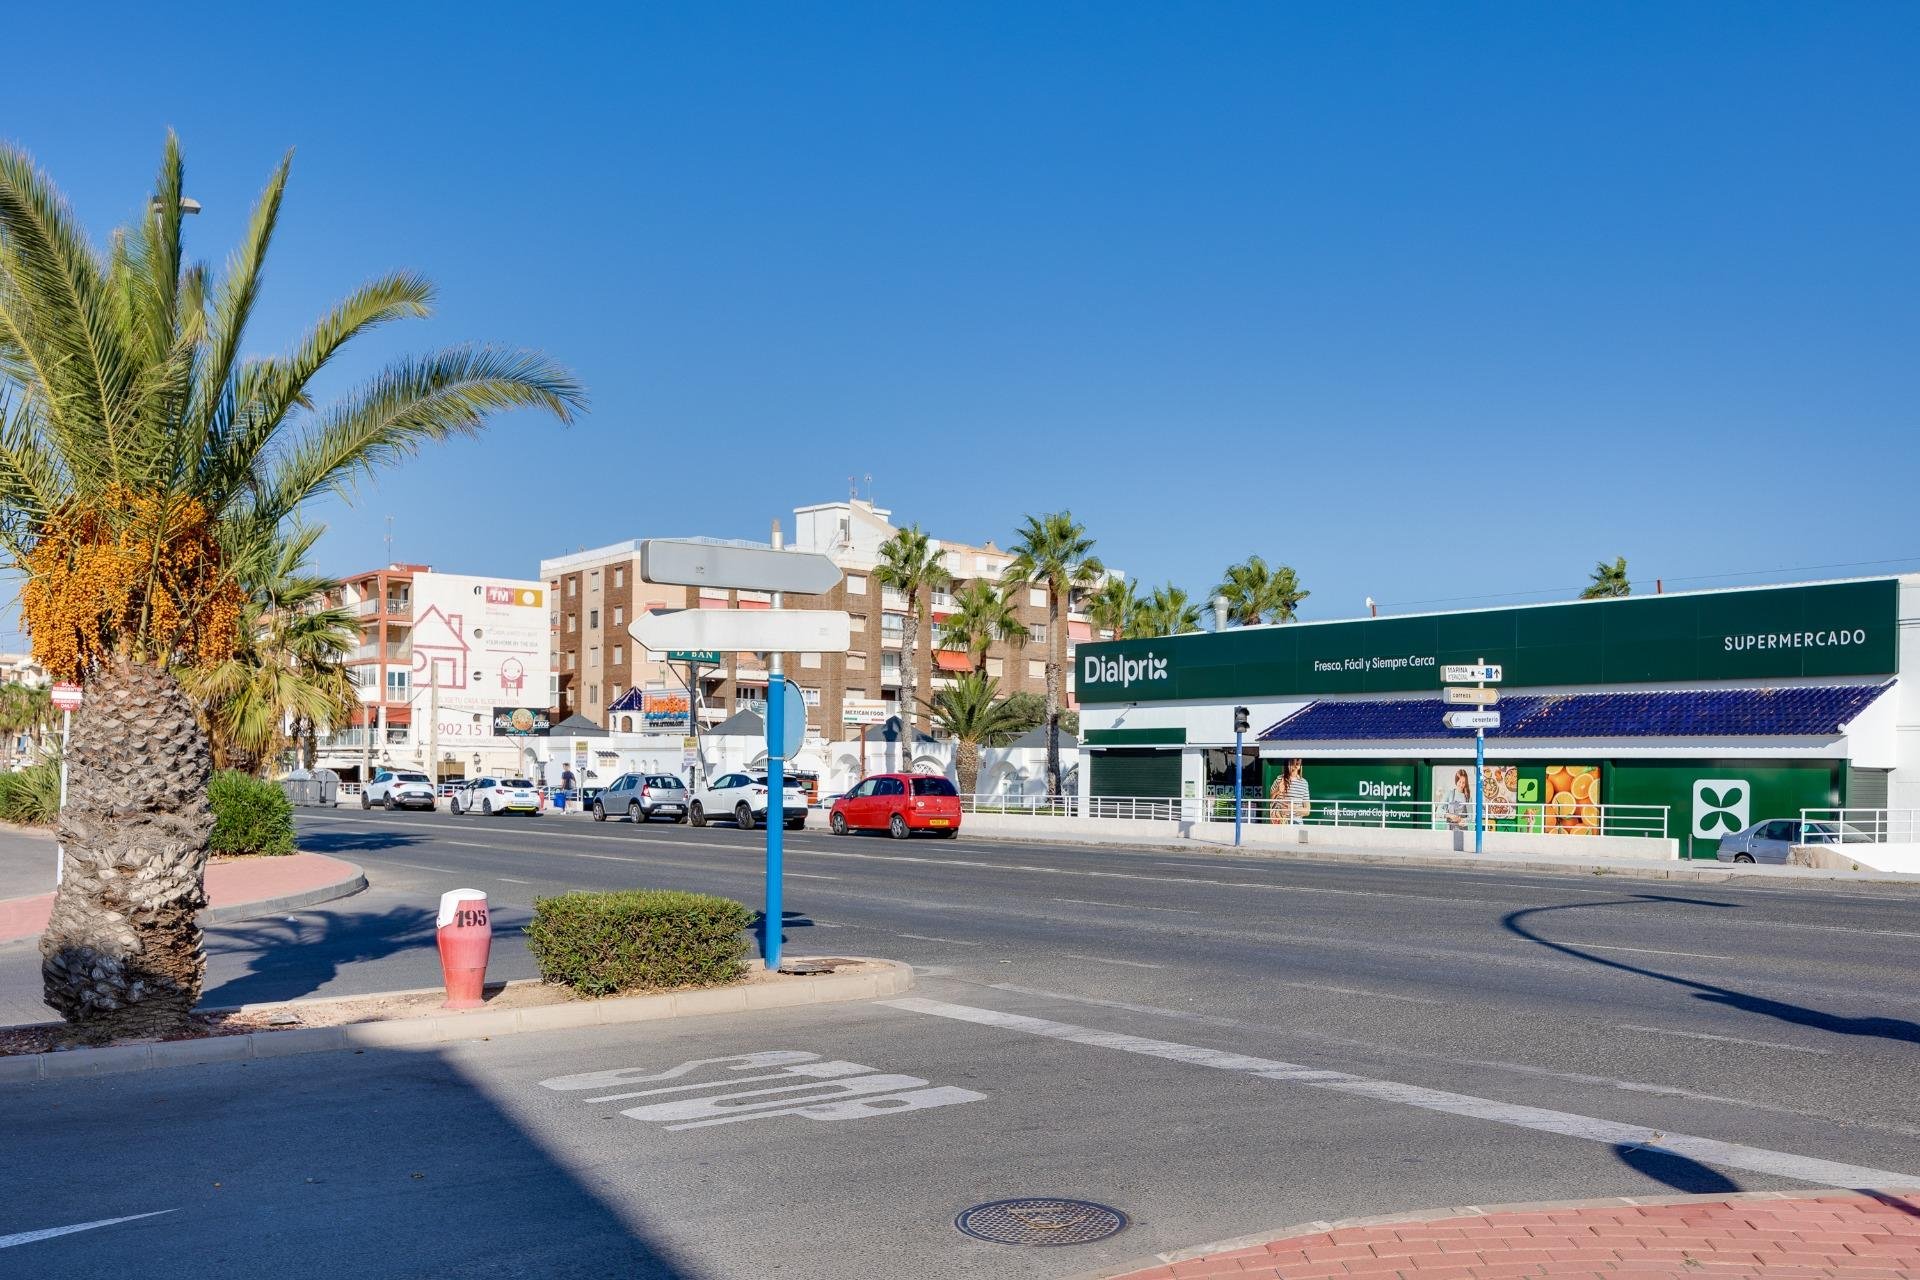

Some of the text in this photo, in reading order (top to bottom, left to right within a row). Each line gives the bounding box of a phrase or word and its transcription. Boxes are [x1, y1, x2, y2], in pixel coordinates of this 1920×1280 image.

[490, 590, 509, 602] TM
[1724, 629, 1866, 651] SUPERMERCADO
[1084, 651, 1168, 688] Dialprix
[1314, 655, 1435, 672] Fresco, Fácil y Siempre Cerca
[845, 709, 869, 717] MEXICAN
[438, 722, 462, 736] 902
[468, 723, 482, 736] 15
[1358, 780, 1412, 800] Dialprix
[1342, 807, 1357, 819] Easy
[455, 909, 487, 928] 195
